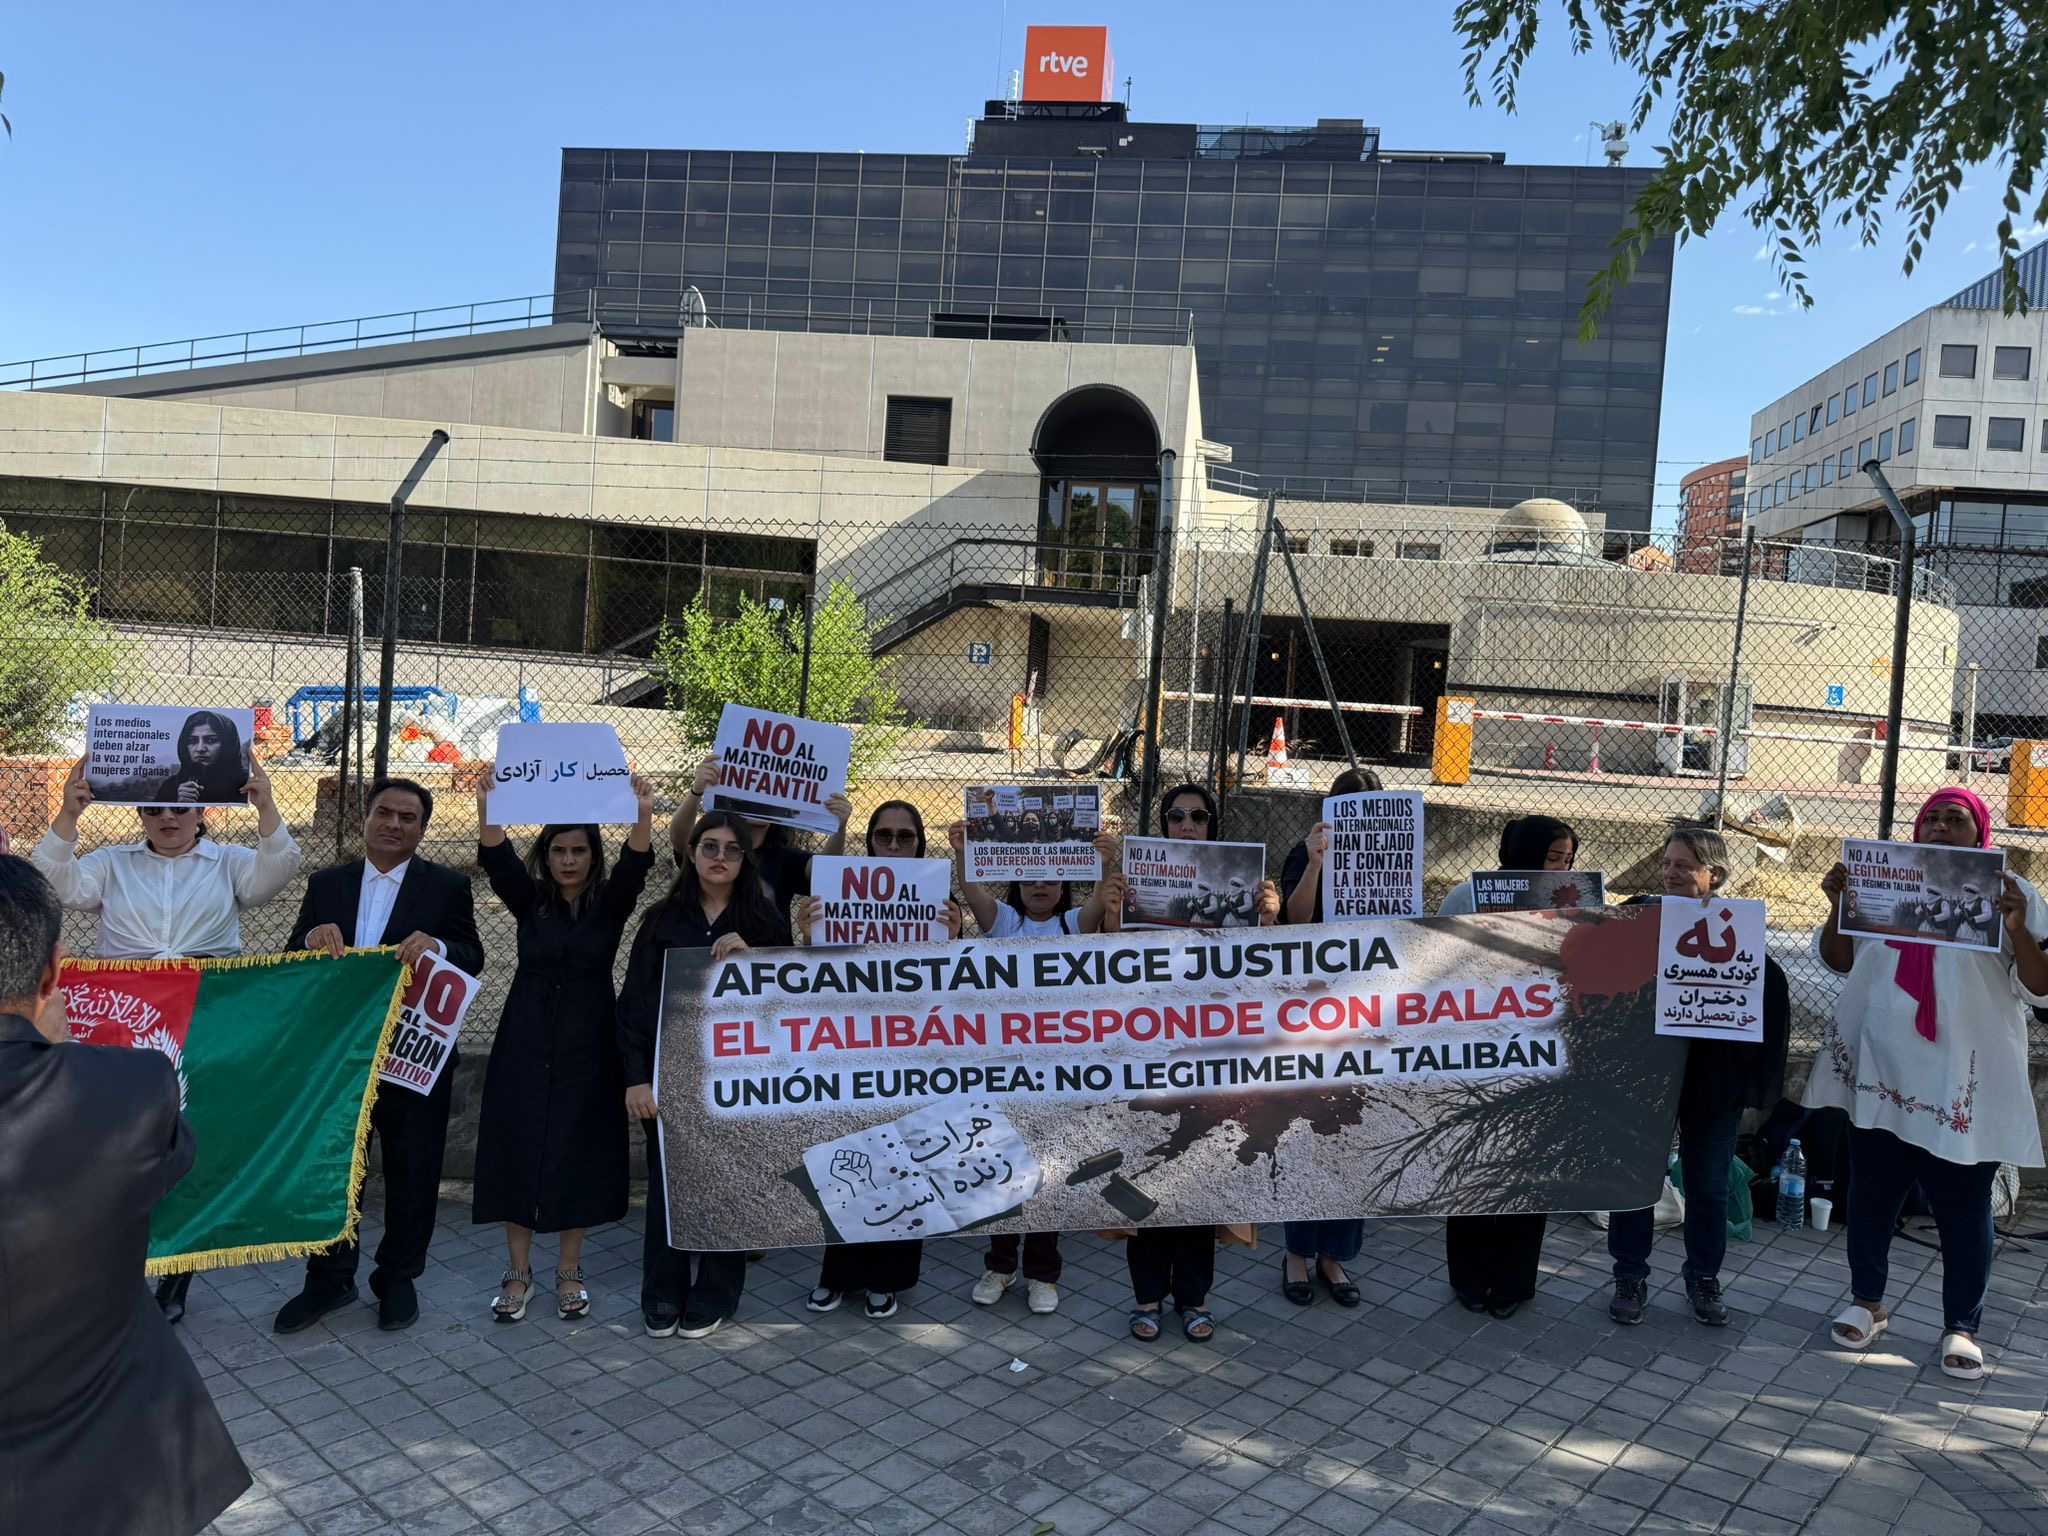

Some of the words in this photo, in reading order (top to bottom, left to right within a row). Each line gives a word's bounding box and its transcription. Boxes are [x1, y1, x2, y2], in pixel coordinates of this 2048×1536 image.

[1040, 52, 1088, 78] rtve
[95, 716, 112, 726] Los
[115, 717, 151, 728] medios
[94, 728, 170, 740] internacionales
[742, 718, 796, 756] NO
[794, 742, 816, 761] AL
[93, 740, 123, 751] deben
[126, 741, 150, 752] alzar
[92, 752, 100, 762] la
[104, 755, 120, 763] voz
[124, 754, 139, 766] por
[142, 754, 156, 764] las
[724, 746, 828, 782] MATRIMONIO
[92, 766, 130, 777] mujeres
[133, 767, 170, 778] afganas
[495, 760, 542, 782] آزادی
[550, 761, 578, 782] کار
[720, 764, 822, 804] INFANTIL
[1334, 800, 1356, 818] LOS
[1362, 798, 1412, 817] MEDIOS
[1334, 818, 1414, 832] INTERNACIONALES
[1334, 834, 1360, 850] HAN
[1365, 833, 1414, 851] DEJADO
[974, 846, 988, 856] LOS
[990, 846, 1030, 856] DERECHOS
[1032, 846, 1042, 856] DE
[1044, 846, 1058, 856] LAS
[1059, 846, 1094, 855] MUJERES
[1130, 848, 1142, 860] NO
[1145, 849, 1152, 861] A
[1154, 849, 1166, 862] LA
[1848, 850, 1862, 862] NO
[1866, 852, 1872, 862] A
[1876, 852, 1888, 864] LA
[974, 856, 994, 866] SON
[996, 856, 1046, 866] DERECHOS
[1049, 856, 1095, 866] HUMANOS
[1334, 852, 1350, 870] DE
[1356, 852, 1413, 870] CONTAR
[1128, 862, 1196, 879] LEGITIMACIÓN
[1848, 864, 1924, 882] LEGITIMACIÓN
[842, 866, 894, 902] NO
[898, 884, 920, 902] AL
[1128, 877, 1139, 886] DEL
[1140, 878, 1166, 888] RÉGIMEN
[1168, 878, 1193, 890] TALIBÁN
[1334, 872, 1349, 888] LA
[1354, 871, 1412, 887] HISTORIA
[1476, 880, 1492, 891] LAS
[1494, 879, 1530, 891] MUJERES
[1848, 878, 1860, 887] DEL
[1862, 878, 1891, 890] RÉGIMEN
[1894, 880, 1920, 892] TALIBÁN
[1334, 888, 1345, 898] DE
[1349, 888, 1366, 898] LAS
[1370, 888, 1412, 898] MUJERES
[1478, 892, 1488, 904] DE
[1490, 892, 1514, 904] HERAT
[824, 902, 936, 921] MATRIMONIO
[1334, 900, 1416, 916] AFGANAS.
[1676, 908, 1736, 964] نه
[1736, 950, 1753, 966] به
[712, 947, 1018, 998] AFGANISTÁN
[1034, 946, 1172, 987] EXIGE
[1184, 937, 1399, 980] JUSTICIA
[1664, 964, 1718, 980] همسری
[1720, 966, 1760, 985] کودک
[1678, 989, 1747, 1007] دختران
[400, 1008, 420, 1028] AL
[712, 1020, 769, 1057] EL
[781, 1004, 987, 1052] TALIBÁN
[1002, 1002, 1264, 1044] RESPONDE
[1276, 994, 1382, 1035] CON
[1396, 983, 1555, 1026] BALAS
[1664, 1006, 1692, 1021] دارند
[1694, 1008, 1734, 1023] تحصیل
[1737, 1011, 1757, 1026] حق
[713, 1067, 841, 1108] UNIÓN
[852, 1065, 1044, 1098] EUROPEA:
[1056, 1064, 1113, 1091] NO
[1124, 1053, 1324, 1090] LEGITIMEN
[1334, 1050, 1384, 1078] AL
[1391, 1033, 1557, 1073] TALIBÁN
[911, 1117, 992, 1163] هرات
